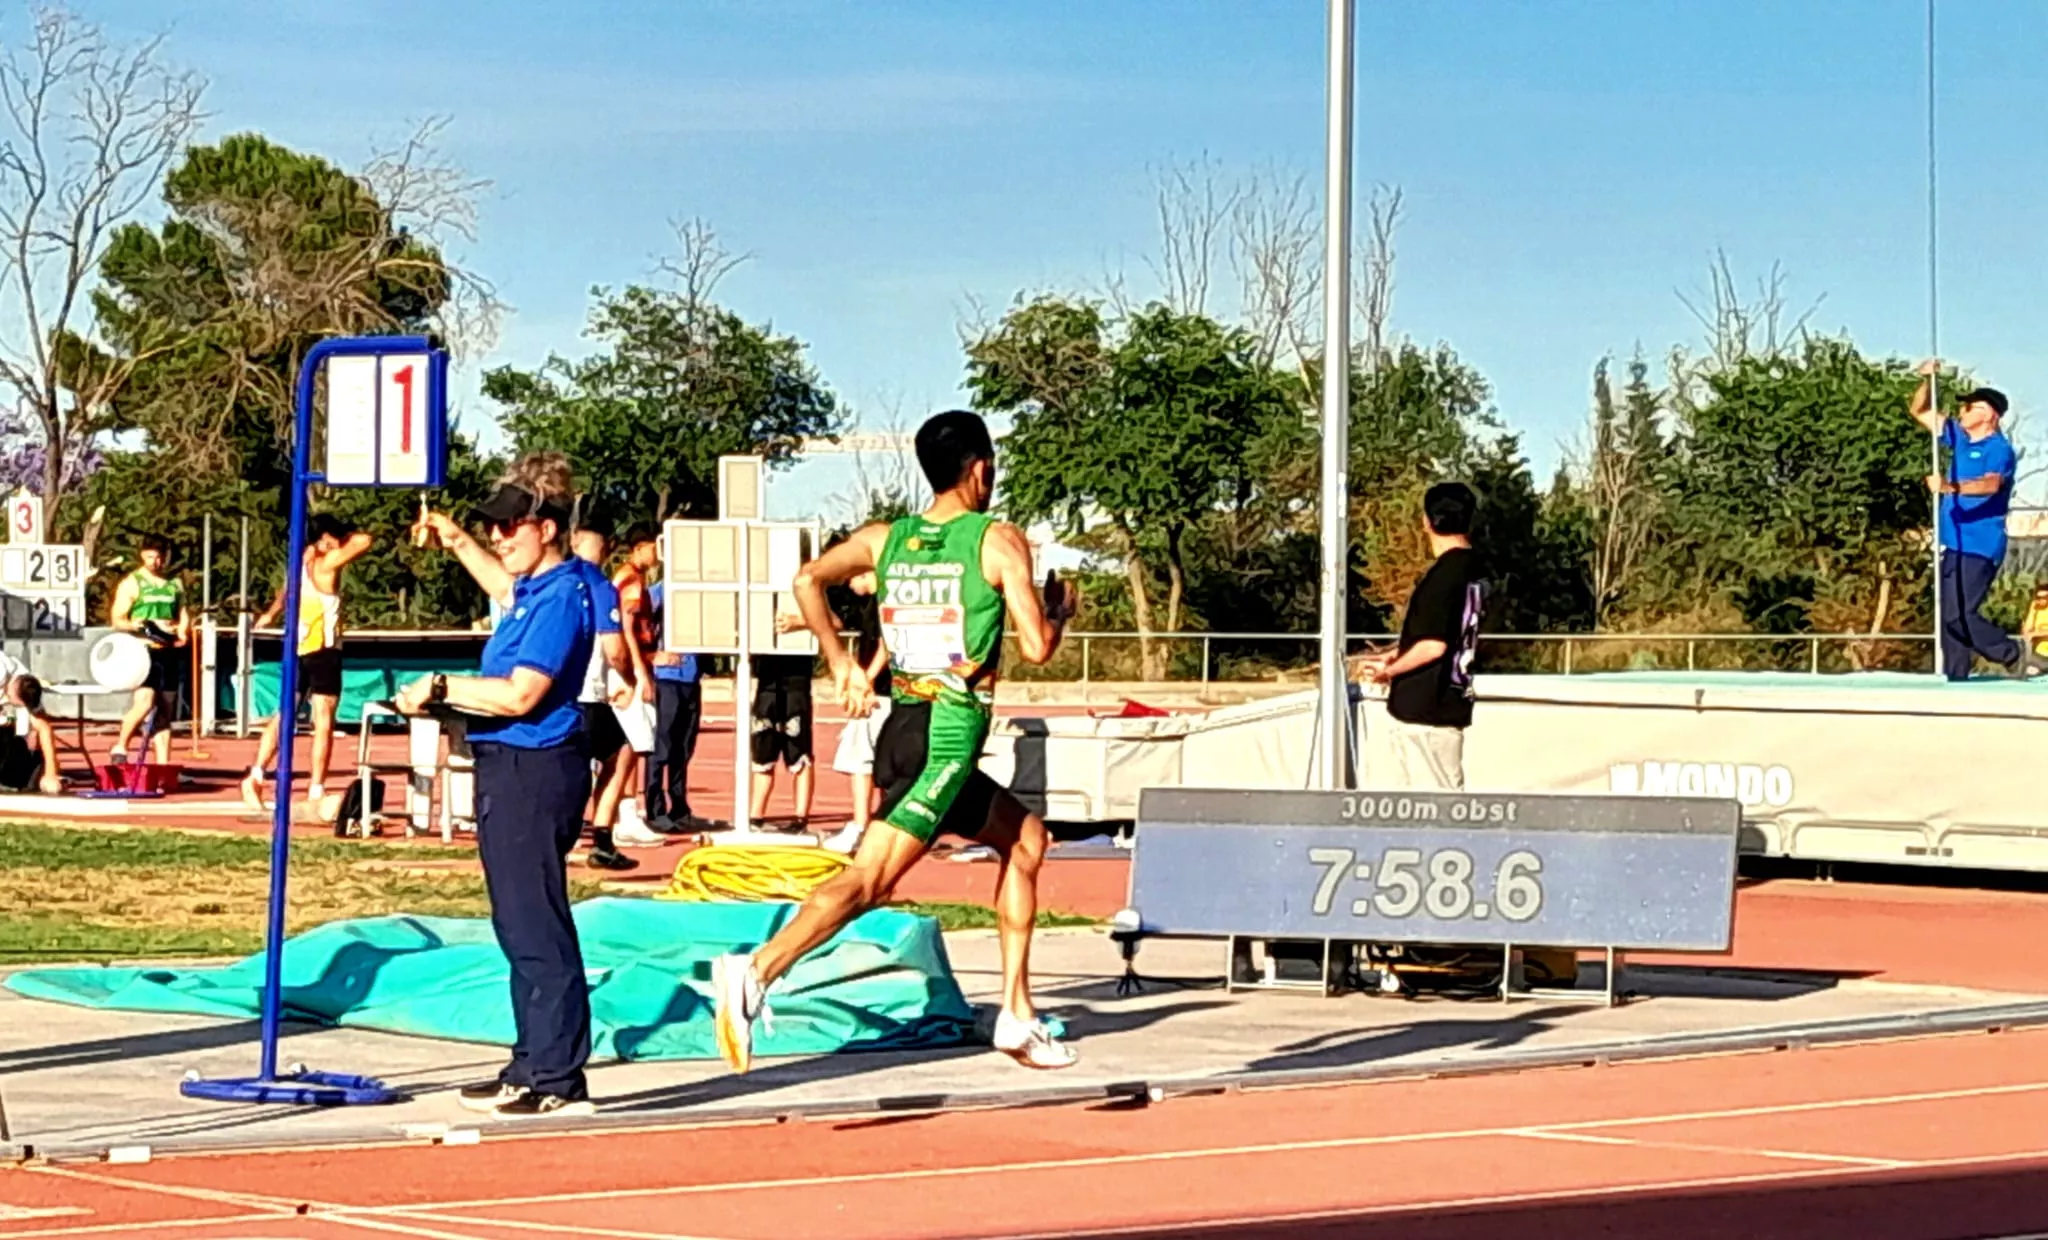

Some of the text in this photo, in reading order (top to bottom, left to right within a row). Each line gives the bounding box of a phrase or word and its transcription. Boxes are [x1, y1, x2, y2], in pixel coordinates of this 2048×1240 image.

[392, 364, 414, 455] 1
[17, 502, 33, 534] 3
[34, 598, 71, 632] 21
[1642, 760, 1794, 807] MONDO
[1342, 797, 1517, 822] 3000m obst
[1308, 847, 1543, 922] 7:58.6
